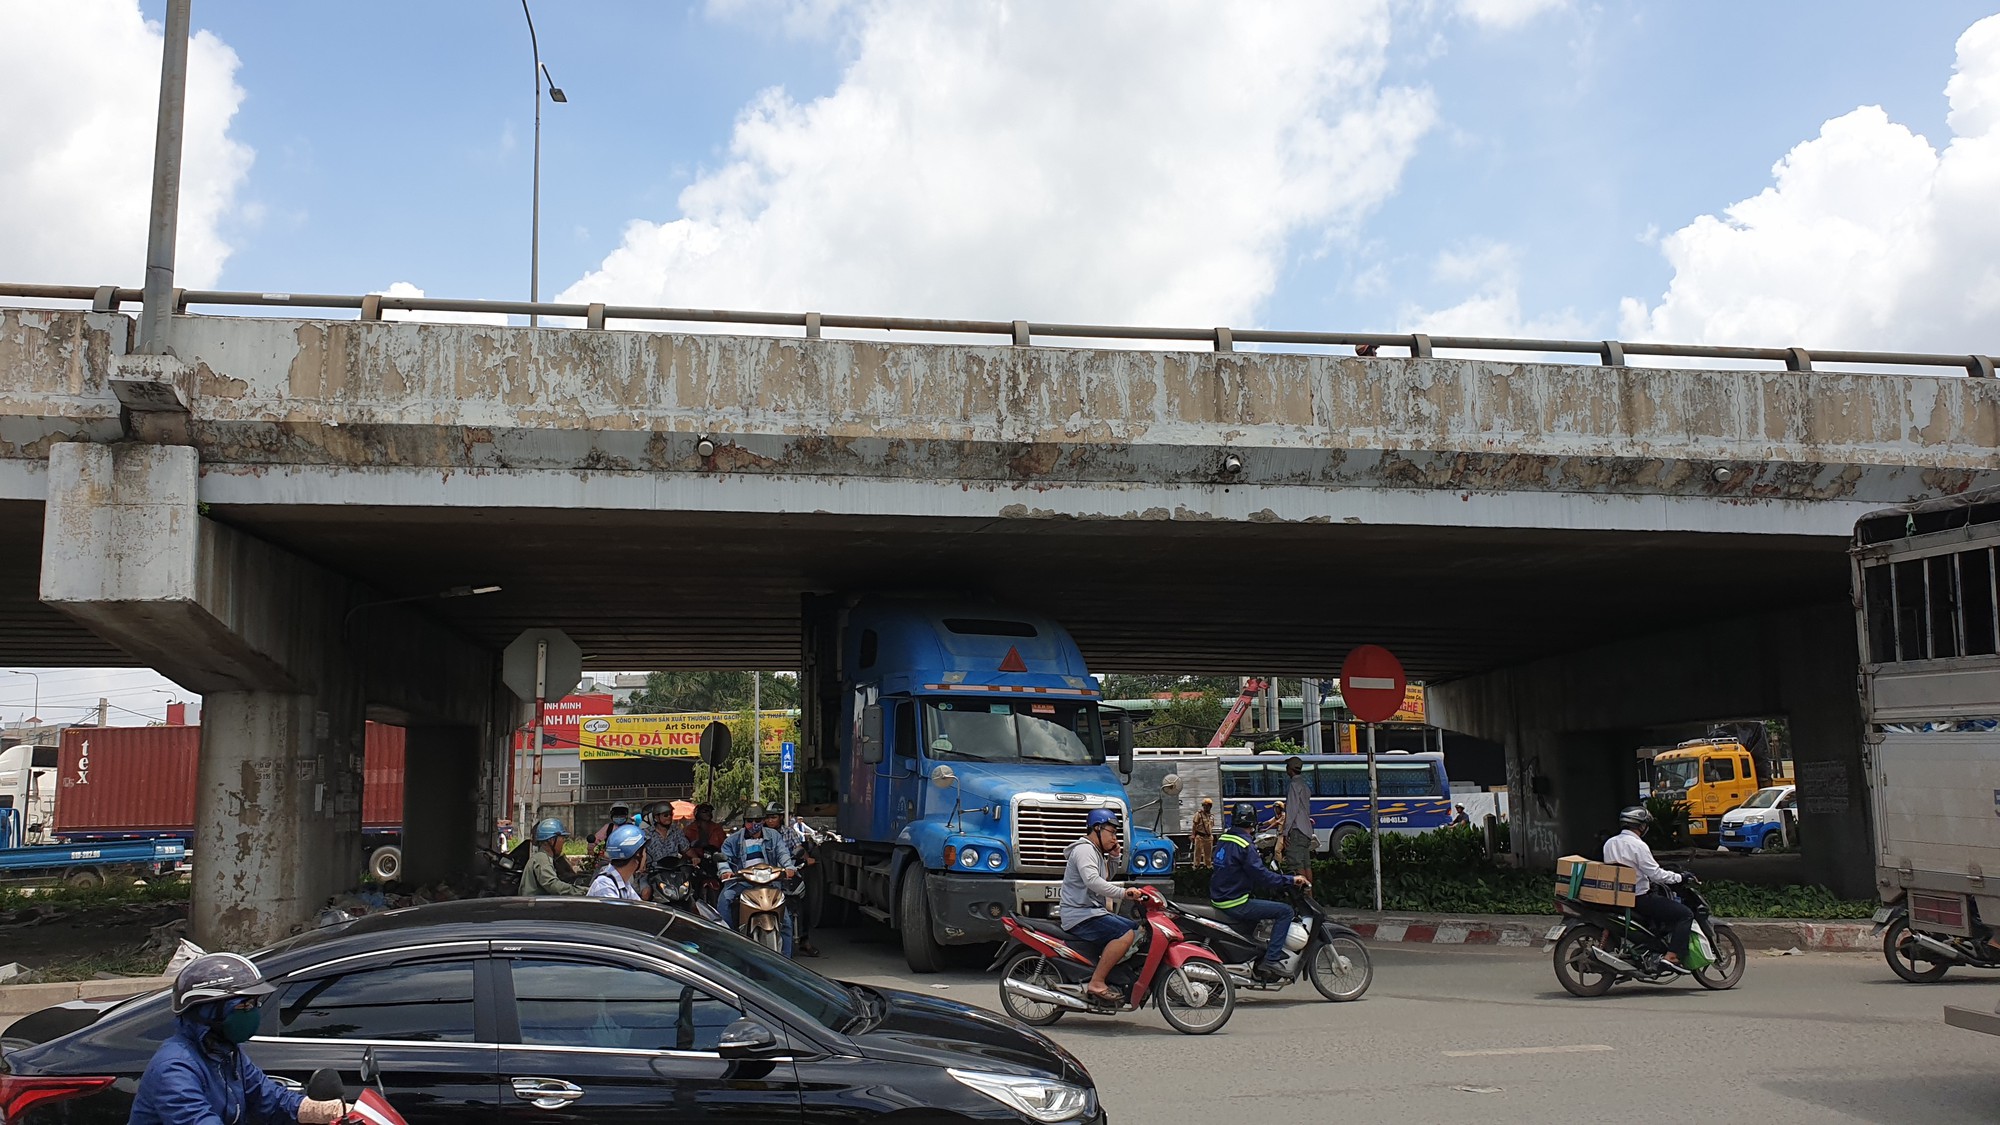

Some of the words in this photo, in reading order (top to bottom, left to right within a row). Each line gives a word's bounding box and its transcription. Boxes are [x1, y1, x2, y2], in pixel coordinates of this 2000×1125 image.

[681, 722, 706, 730] Stone
[596, 734, 634, 748] KHO
[638, 730, 662, 746] ĐÁ
[76, 740, 89, 784] tex
